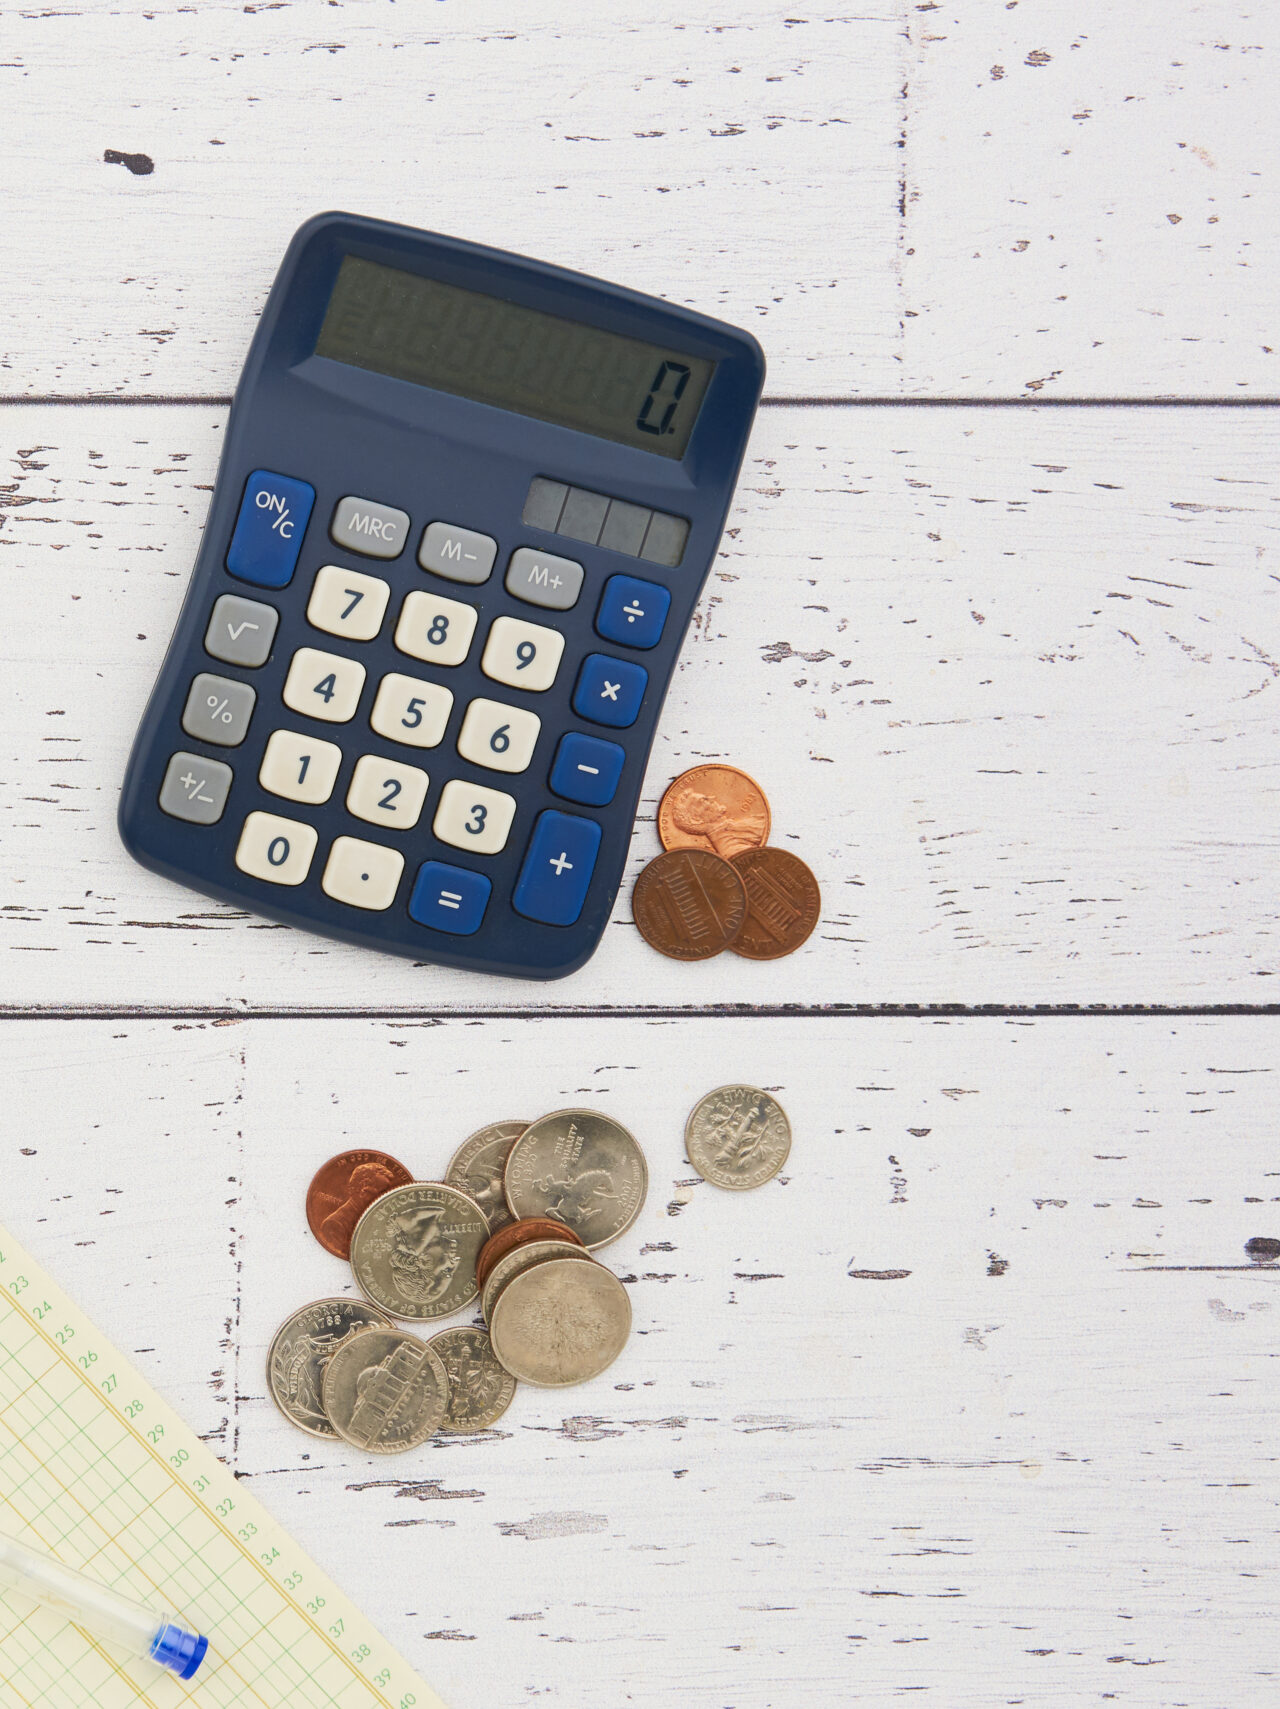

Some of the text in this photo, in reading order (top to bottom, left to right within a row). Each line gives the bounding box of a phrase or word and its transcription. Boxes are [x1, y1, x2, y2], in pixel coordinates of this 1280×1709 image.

[348, 512, 397, 541] MRC
[527, 565, 563, 589] M+
[340, 588, 365, 620] 7
[426, 614, 450, 646] 8
[515, 640, 537, 671] 9
[312, 673, 337, 704] 4
[206, 695, 233, 724] %
[401, 697, 427, 729] 5
[489, 723, 511, 754] 6
[297, 755, 311, 785] 1
[377, 778, 402, 811] 2
[464, 804, 488, 835] 3
[267, 836, 291, 867] 0
[724, 893, 742, 931] ONE
[511, 1133, 537, 1199] WYOMING
[8, 1274, 30, 1296] 23
[31, 1299, 54, 1321] 24
[294, 1306, 354, 1329] GEORGIA
[313, 1316, 341, 1329] 1788
[55, 1324, 77, 1346] 25
[77, 1349, 99, 1370] 26
[100, 1372, 119, 1395] 27
[123, 1399, 145, 1419] 28
[146, 1423, 165, 1445] 29
[168, 1448, 191, 1469] 30
[191, 1473, 212, 1494] 31
[215, 1497, 236, 1519] 32
[237, 1521, 259, 1542] 33
[260, 1546, 281, 1567] 34
[282, 1570, 305, 1591] 35
[306, 1595, 327, 1615] 36
[328, 1616, 345, 1640] 37
[351, 1642, 372, 1665] 38
[371, 1667, 392, 1688] 39
